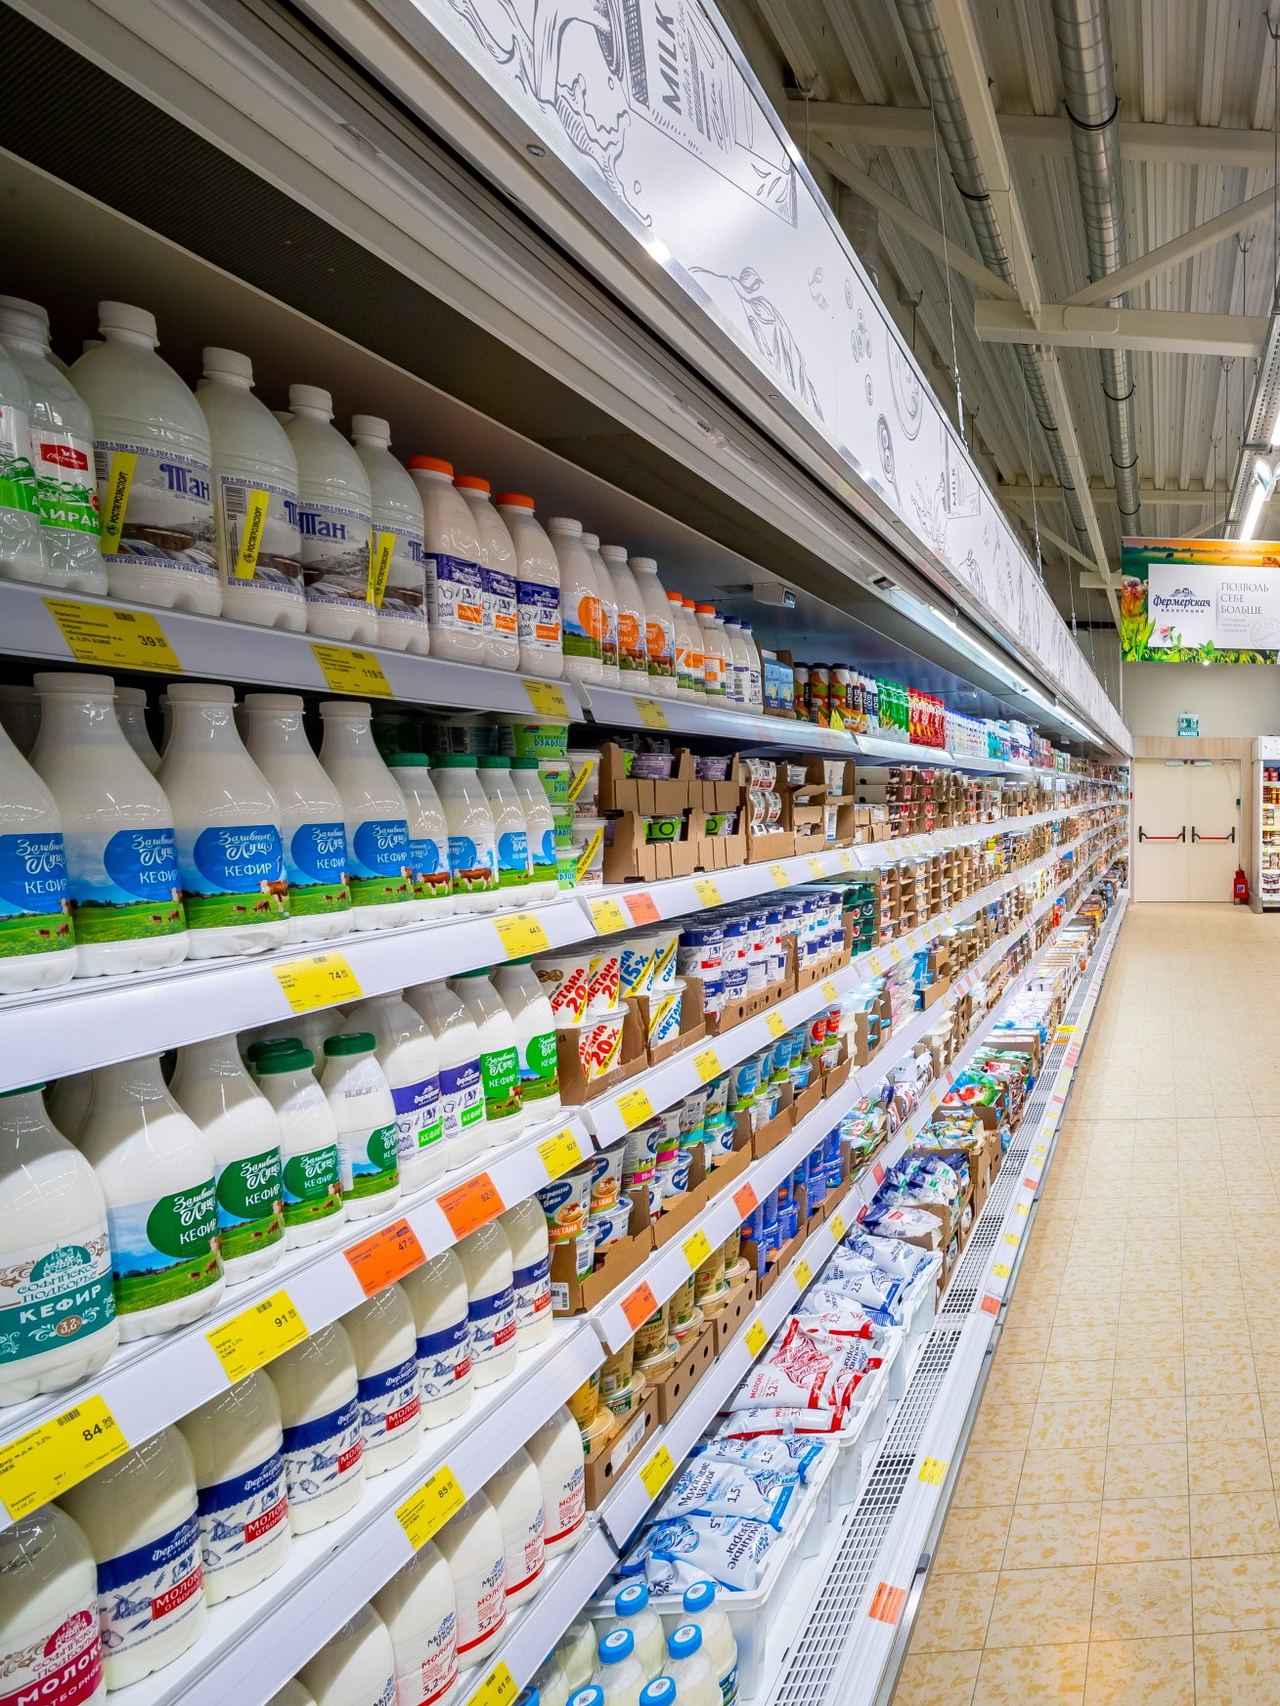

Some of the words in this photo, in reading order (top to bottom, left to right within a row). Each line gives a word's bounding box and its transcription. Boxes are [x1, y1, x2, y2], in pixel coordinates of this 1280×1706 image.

[655, 0, 682, 116] MILK
[159, 463, 211, 501] Тан
[111, 471, 129, 524] РОСТАГРОЭКСПОРТ
[247, 507, 263, 553] РОСТАГРОЭКСПОРТ
[300, 512, 346, 540] Тан
[376, 547, 390, 588] РОСТАГРОЭКСПОРТ
[1221, 582, 1269, 593] ПОЗВОЛЬ
[1153, 593, 1211, 608] Фермерская
[1221, 594, 1245, 603] СЕБЕ
[1221, 605, 1263, 615] БОЛЬШЕ
[138, 635, 156, 647] 39
[362, 669, 378, 679] 119
[377, 852, 408, 864] КЕФИР
[225, 864, 272, 877] КЕФИР
[25, 879, 67, 894] КЕФИР
[329, 972, 342, 982] 74
[588, 957, 618, 1004] МЕТАНА
[552, 968, 585, 1015] МЕТАНА
[489, 1074, 515, 1087] КЕФИР
[420, 1126, 442, 1143] КЕФИР
[304, 1173, 334, 1189] КЕФИР
[245, 1184, 280, 1207] КЕФИР
[480, 1192, 491, 1203] 92
[180, 1219, 217, 1245] КЕФИР
[548, 1224, 577, 1237] СМЕТАНА
[398, 1240, 408, 1251] 47
[18, 1261, 98, 1294] СОФИЙСКОЕ
[23, 1271, 97, 1302] ПОДВОРЬЕ
[20, 1285, 101, 1324] КЕФИР
[275, 1314, 288, 1327] 91
[750, 1373, 765, 1399] МОЛОКО
[82, 1423, 103, 1441] 84
[438, 1486, 448, 1498] 85
[45, 1663, 103, 1706] ТБОРНОЕ
[423, 1672, 447, 1697] 3,2%
[497, 1682, 507, 1695] 61
